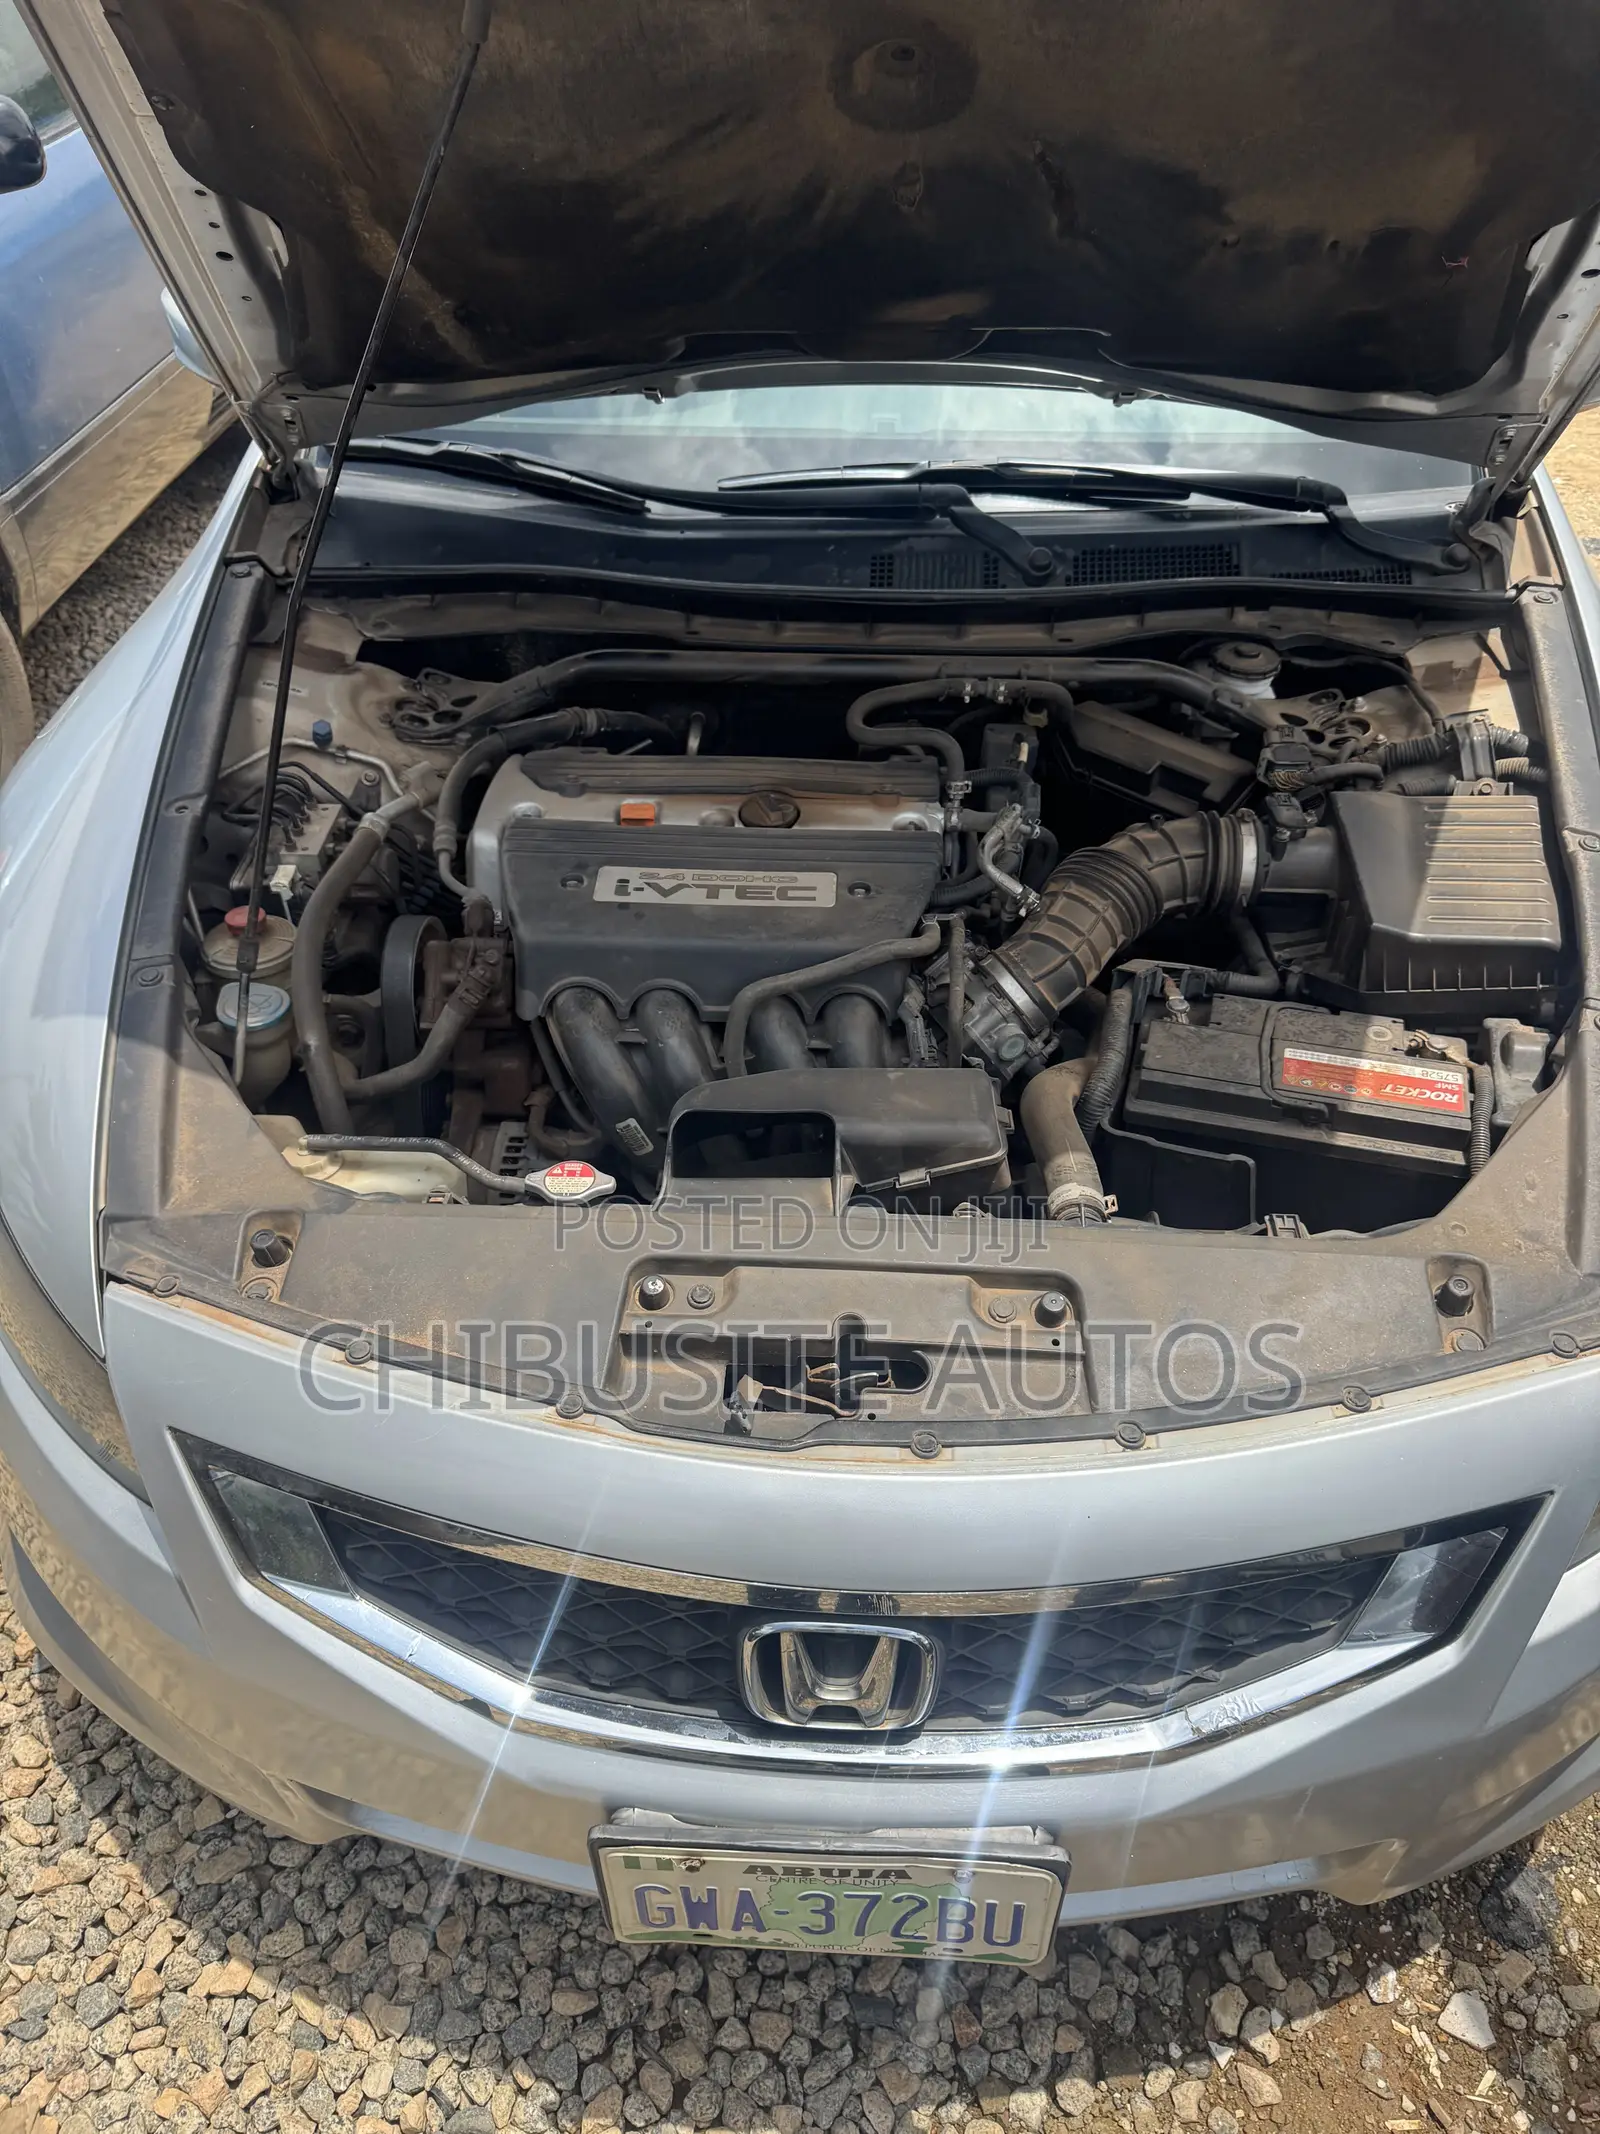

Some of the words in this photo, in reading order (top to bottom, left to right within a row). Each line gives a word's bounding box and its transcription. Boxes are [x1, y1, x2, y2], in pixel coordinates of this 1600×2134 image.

[614, 878, 818, 902] i-VTEC
[1421, 1069, 1460, 1082] 57528
[1380, 1083, 1461, 1103] ROCKET
[1434, 1082, 1460, 1091] SMF
[742, 1864, 913, 1880] ABUJA
[755, 1874, 818, 1885] CENTRE
[823, 1878, 847, 1886] OF
[852, 1878, 899, 1887] UNITY
[634, 1884, 1026, 1947] GWA-372BU
